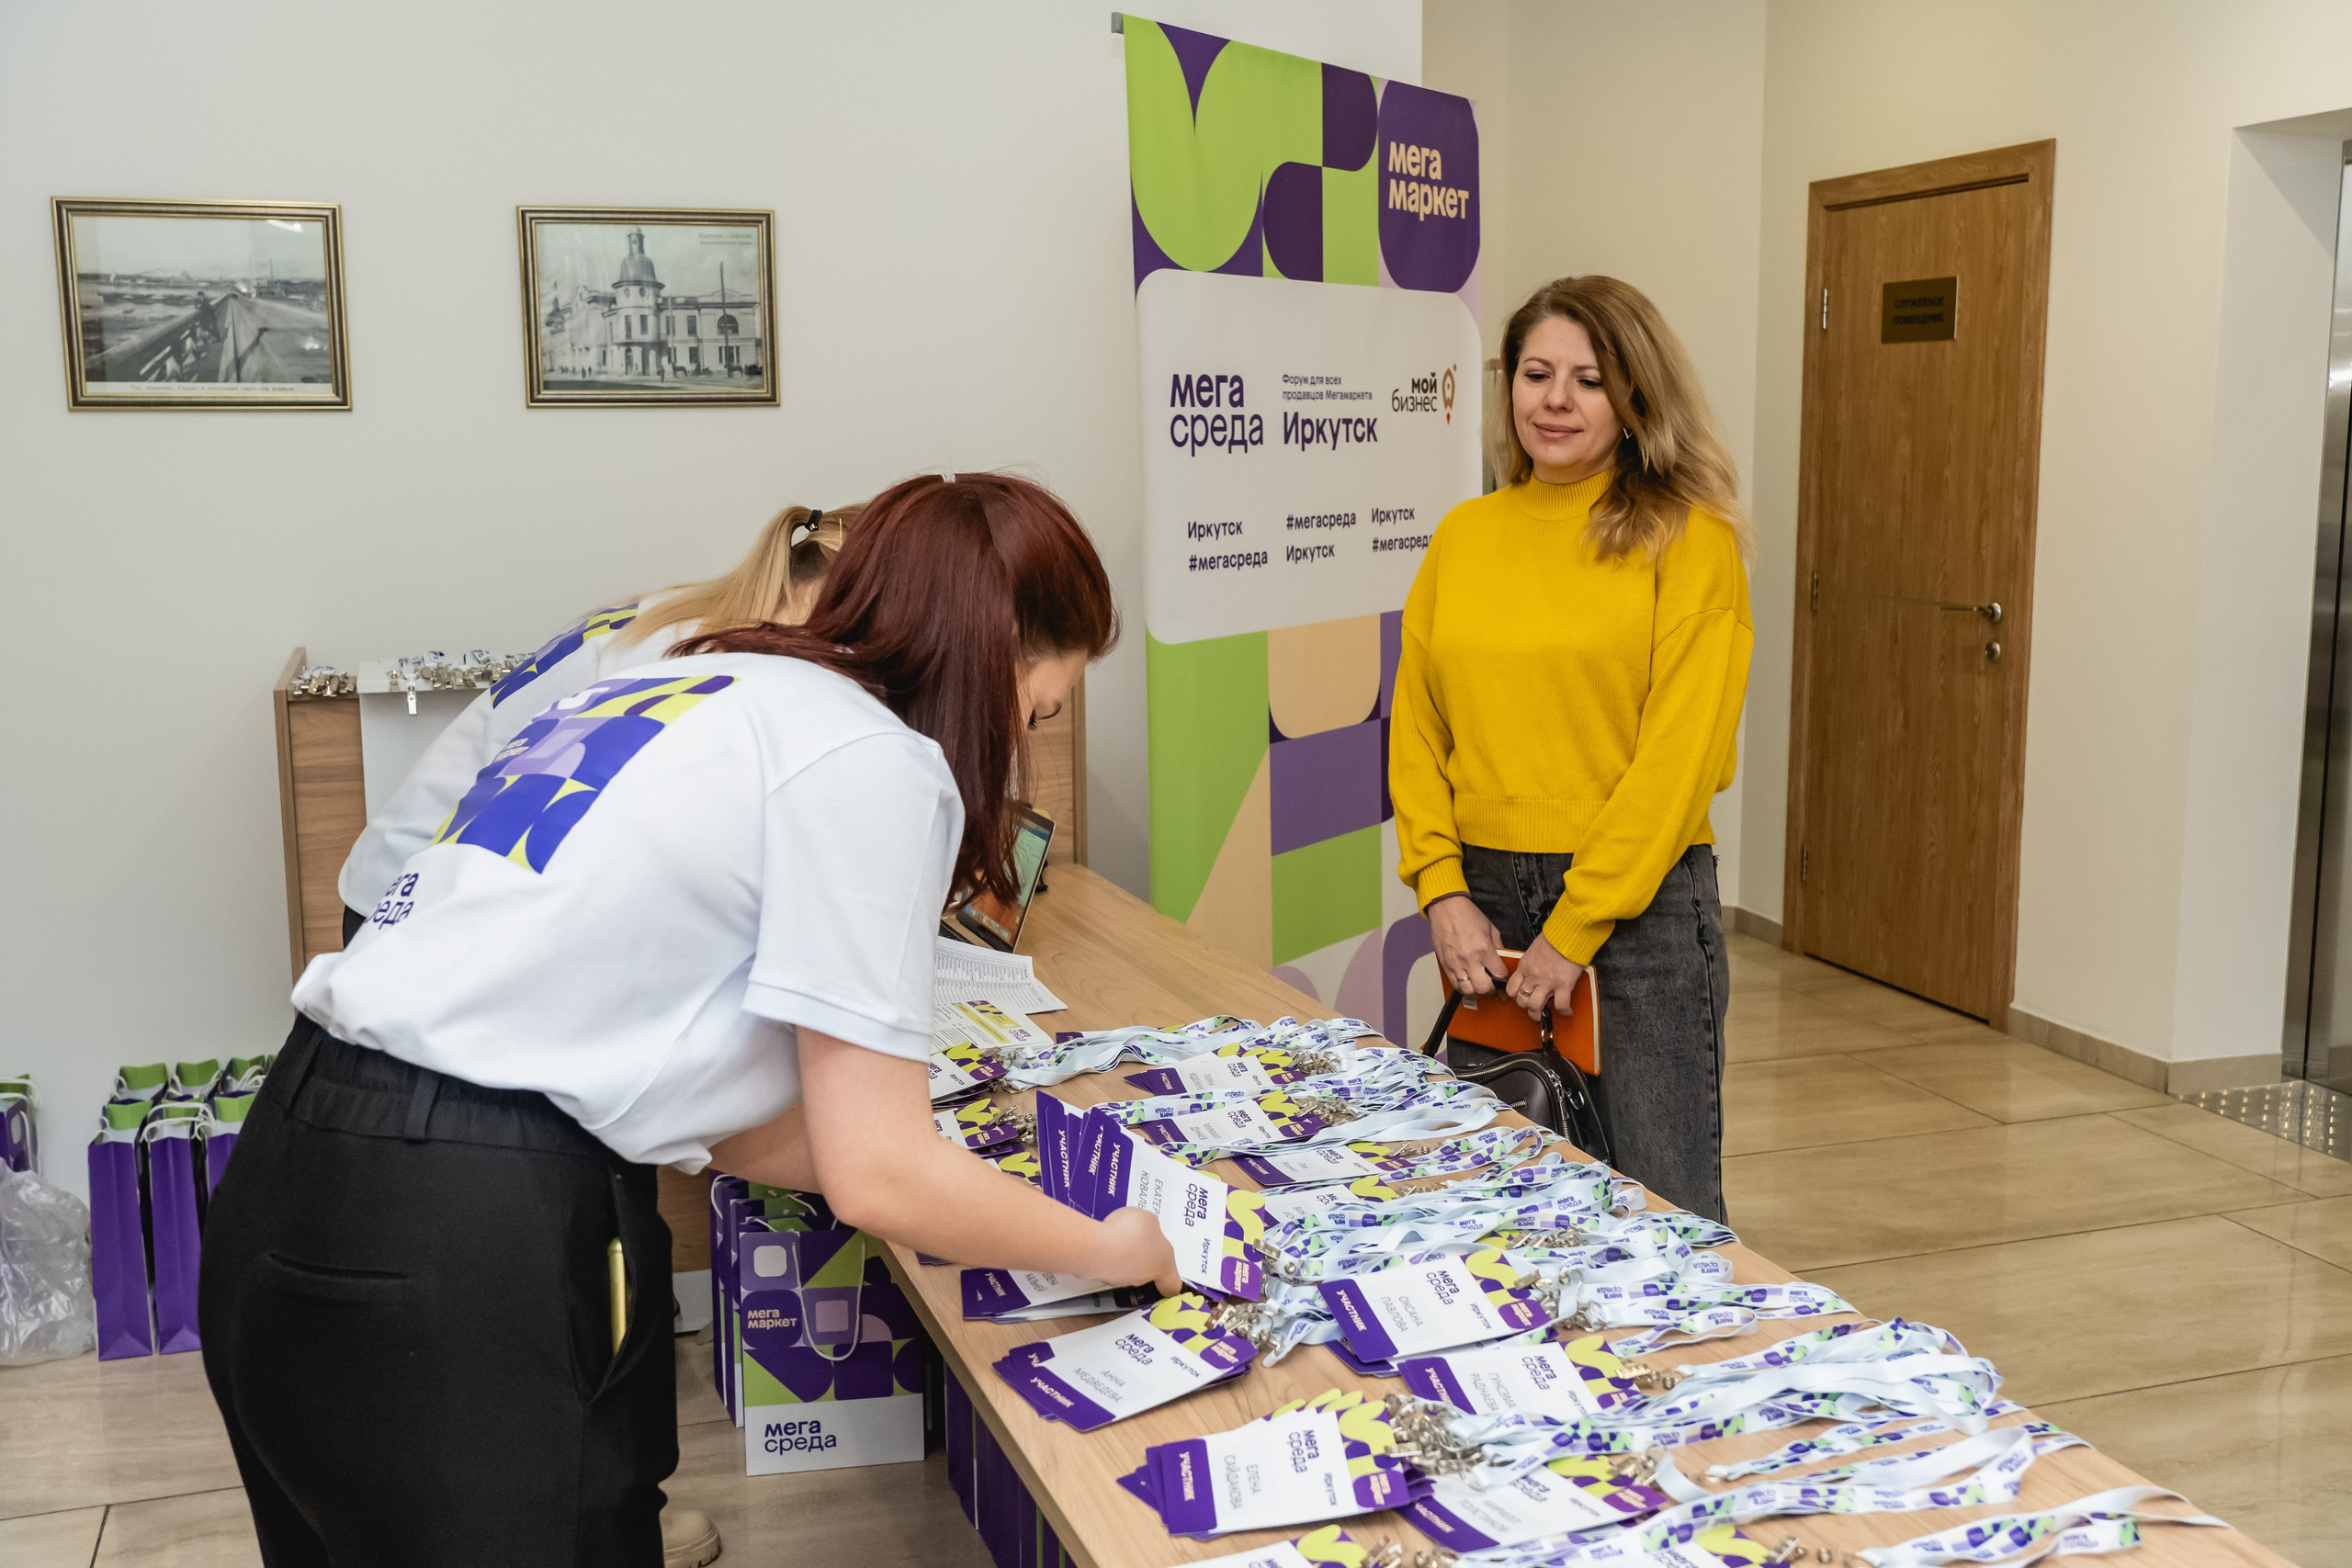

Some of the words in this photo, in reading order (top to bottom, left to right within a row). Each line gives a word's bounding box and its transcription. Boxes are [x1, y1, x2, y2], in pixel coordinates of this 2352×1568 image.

[1388, 141, 1442, 180] мега
[1388, 178, 1469, 221] маркет
[1894, 296, 1945, 310] СЛУЖЕБНОЕ
[1894, 312, 1945, 326] ПОМЕЩЕНИЕ
[1170, 373, 1244, 408] мега
[1282, 374, 1308, 386] Форум
[1310, 376, 1324, 386] для
[1325, 376, 1342, 385] всех
[1411, 372, 1438, 394] мой
[1283, 390, 1324, 402] продавцов
[1325, 390, 1373, 402] Мегамаркета
[1391, 389, 1438, 412] бизнес
[1170, 413, 1263, 457] среда
[1283, 412, 1378, 452] Иркутск
[1286, 512, 1356, 531] #мегасреда
[1371, 507, 1416, 525] Иркутск
[1187, 521, 1243, 542] Иркутск
[1189, 551, 1268, 572] #мегасреда
[1286, 544, 1335, 565] Иркутск
[385, 873, 419, 897] ега
[1107, 1143, 1121, 1197] УЧАСТНИК
[1153, 1178, 1164, 1216] ЕКАТЕР
[1184, 1183, 1198, 1227] среда
[1197, 1187, 1209, 1220] мега
[1200, 1237, 1211, 1275] Иркутск
[1426, 1272, 1454, 1305] среда
[1436, 1270, 1460, 1294] мега
[747, 1308, 780, 1319] мега
[747, 1317, 797, 1330] маркет
[1336, 1289, 1368, 1332] УЧАСТНИК
[1380, 1296, 1409, 1332] ПАВЛОВА
[1398, 1295, 1424, 1326] ОКСАНА
[1114, 1338, 1154, 1366] среда
[1125, 1333, 1155, 1354] мега
[1099, 1370, 1125, 1388] АННА
[1521, 1356, 1550, 1391] среда
[1533, 1355, 1557, 1381] мега
[1030, 1376, 1075, 1408] УЧАСТНИК
[764, 1420, 821, 1438] мега
[764, 1433, 837, 1456] среда
[1287, 1432, 1307, 1473] среда
[1304, 1430, 1320, 1461] мега
[1180, 1451, 1195, 1502] УЧАСТНИК
[1247, 1464, 1261, 1495] ЕЛЕНА
